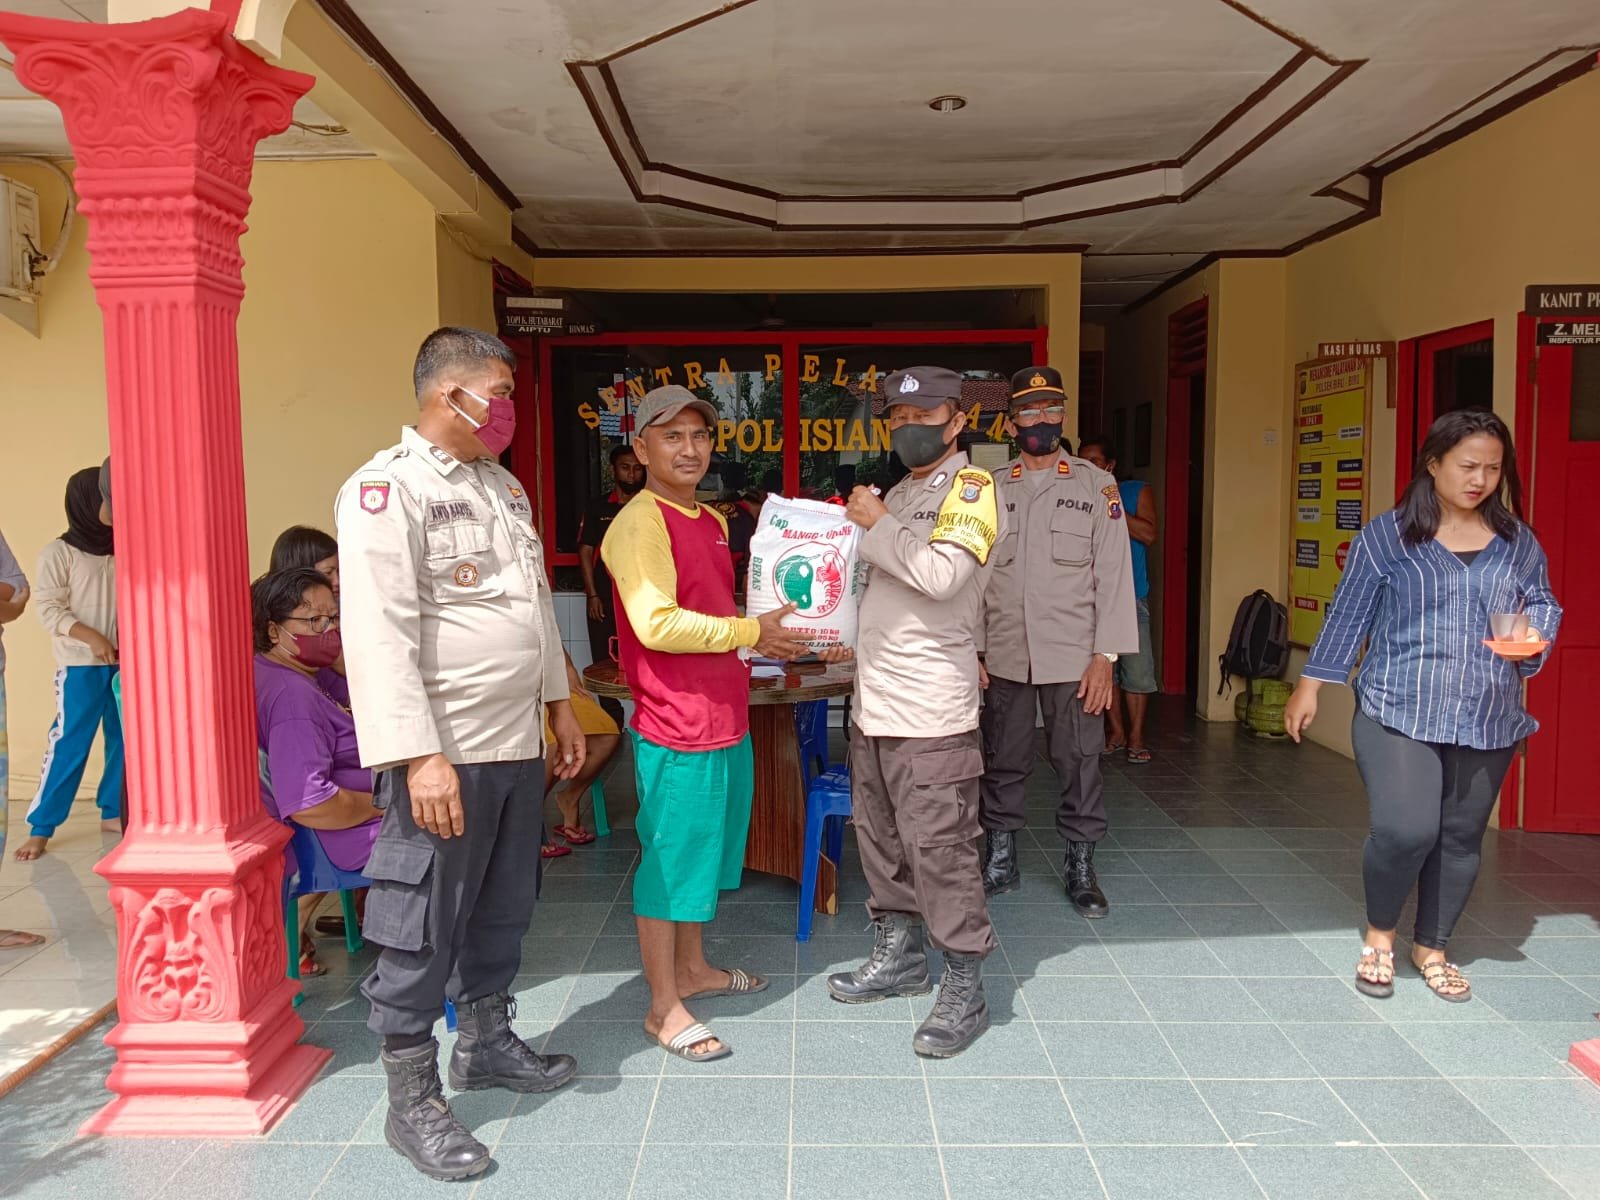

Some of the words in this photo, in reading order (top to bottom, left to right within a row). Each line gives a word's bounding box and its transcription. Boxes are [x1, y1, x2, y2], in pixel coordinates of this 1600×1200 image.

[1540, 292, 1582, 308] KANIT
[1554, 323, 1568, 336] Z.
[1324, 344, 1345, 356] KASI
[1349, 343, 1381, 355] HUMAS
[577, 357, 735, 430] SENTRA
[1056, 498, 1093, 514] POLRI
[769, 513, 789, 530] Cap
[752, 555, 763, 591] BERAS
